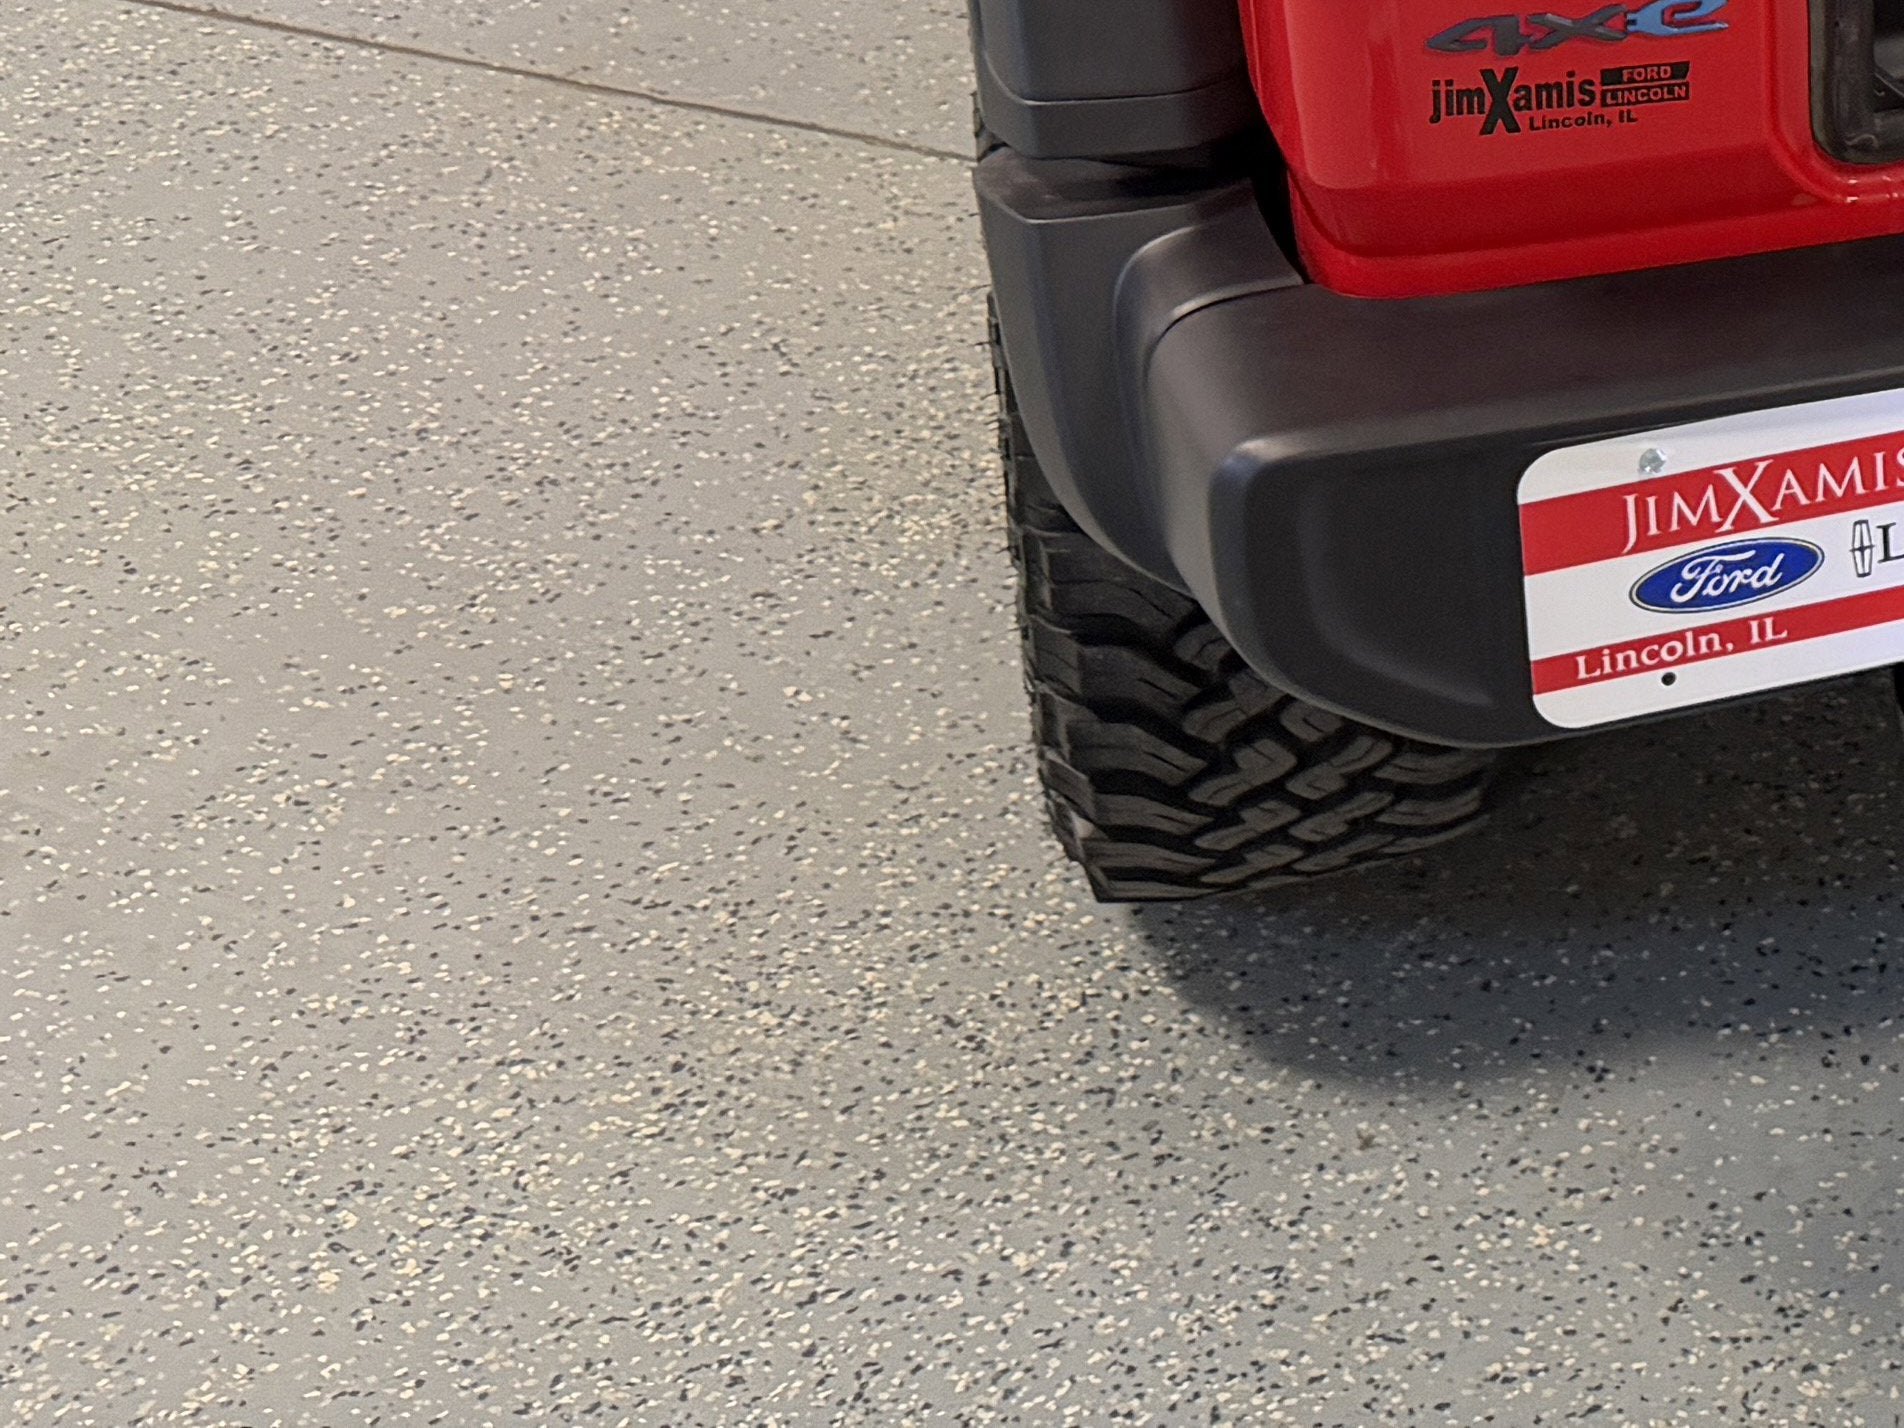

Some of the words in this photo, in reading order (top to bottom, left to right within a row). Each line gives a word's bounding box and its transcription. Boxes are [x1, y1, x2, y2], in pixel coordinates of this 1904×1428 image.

[1622, 65, 1672, 84] FORD
[1606, 85, 1687, 106] LINCOLN
[1529, 112, 1613, 132] Lincoln,
[1619, 109, 1638, 123] IL
[1670, 550, 1784, 605] Ford
[1575, 629, 1735, 682] Lincoln,
[1748, 620, 1789, 646] IL
